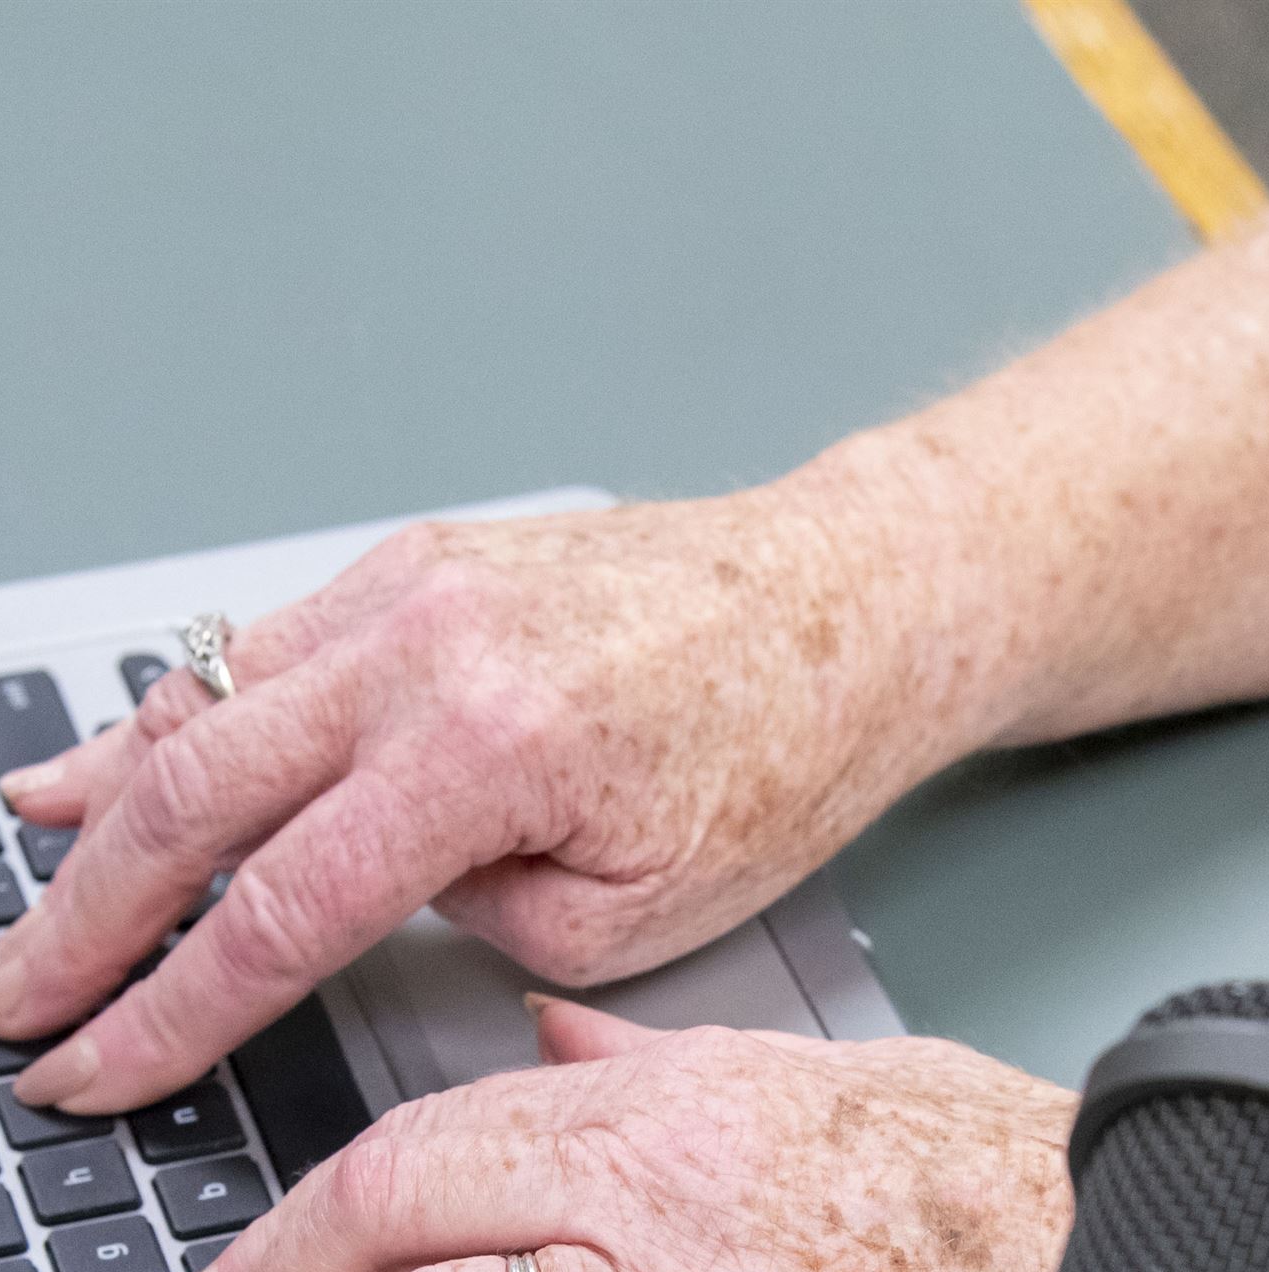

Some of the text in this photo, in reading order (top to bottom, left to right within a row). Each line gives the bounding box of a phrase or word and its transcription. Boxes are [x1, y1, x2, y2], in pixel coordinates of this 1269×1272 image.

[174, 1107, 197, 1124] n
[64, 1168, 92, 1185] h
[199, 1183, 226, 1200] b
[97, 1243, 128, 1260] g
